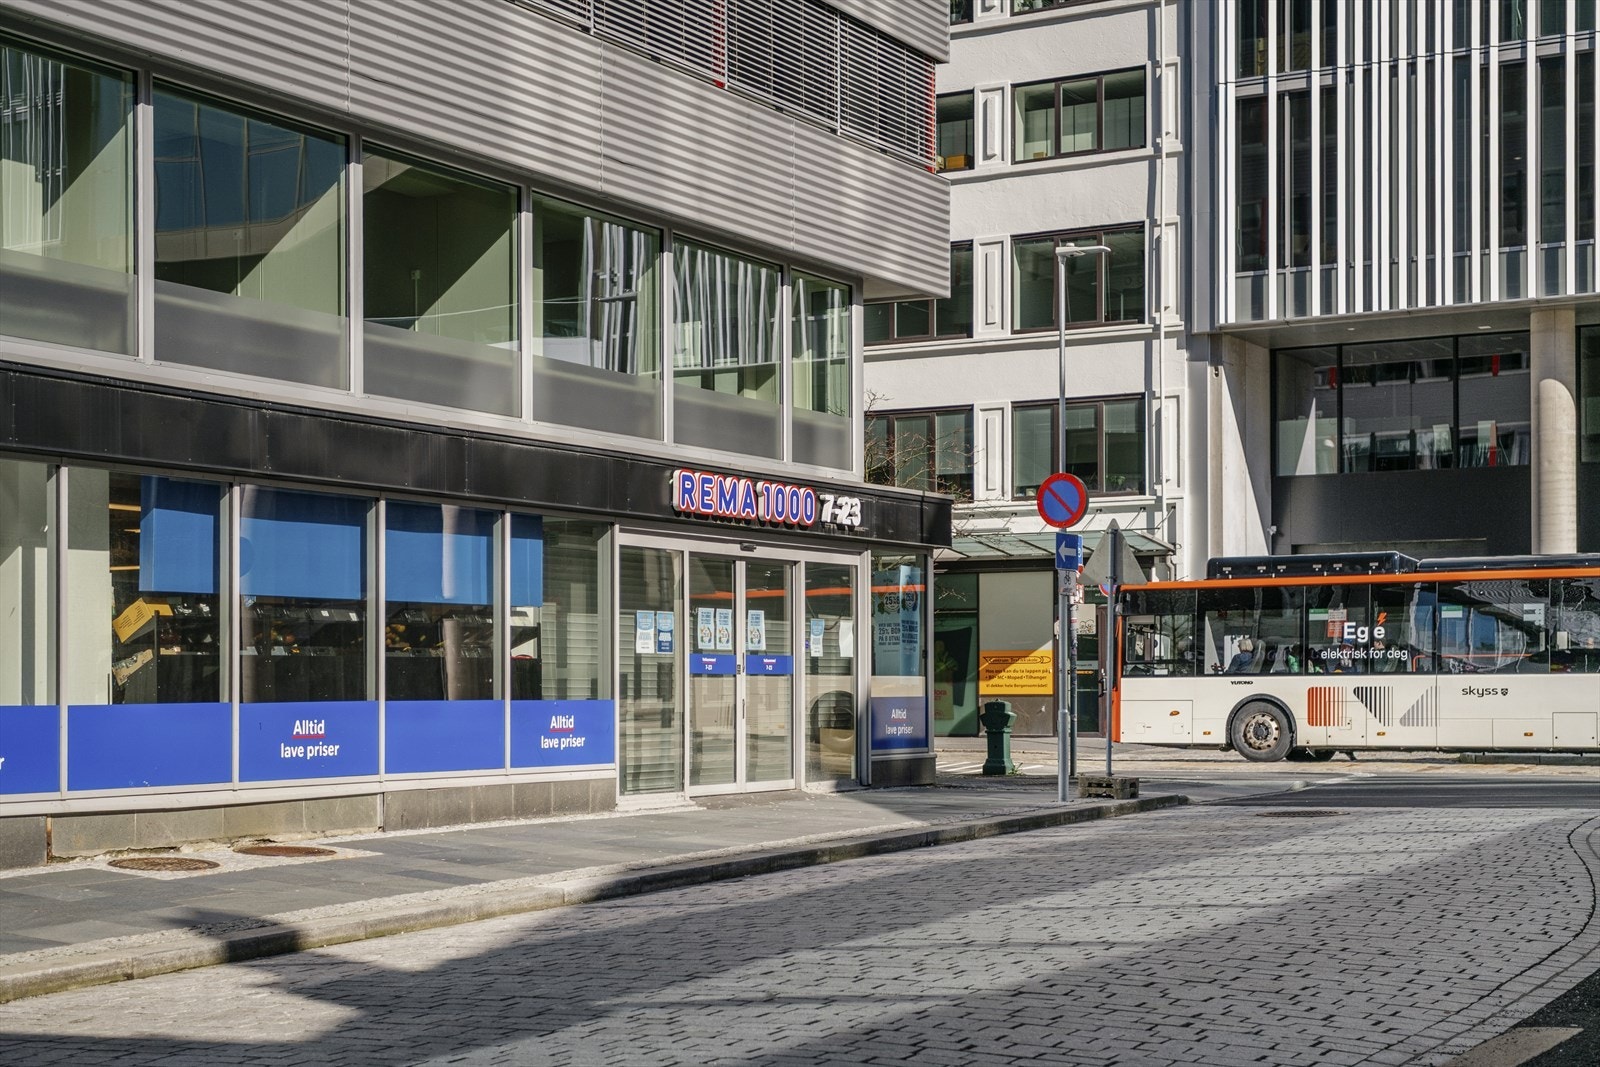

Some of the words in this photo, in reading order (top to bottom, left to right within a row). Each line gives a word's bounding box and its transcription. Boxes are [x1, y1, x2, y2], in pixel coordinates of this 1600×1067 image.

[677, 469, 757, 519] REMA
[760, 481, 816, 526] 1000
[820, 494, 861, 526] 7-23
[1343, 621, 1369, 643] Eg
[1321, 647, 1367, 659] elektrisk
[1369, 647, 1384, 659] for
[1387, 647, 1408, 660] deg
[1461, 686, 1498, 698] skyss
[550, 714, 575, 729] Alltid
[890, 708, 907, 719] Alltid
[293, 719, 325, 735] Alltid
[885, 724, 897, 735] lave
[897, 723, 914, 736] priser
[541, 735, 559, 749] lave
[560, 733, 586, 750] priser
[280, 742, 305, 758] lave
[306, 741, 340, 760] priser
